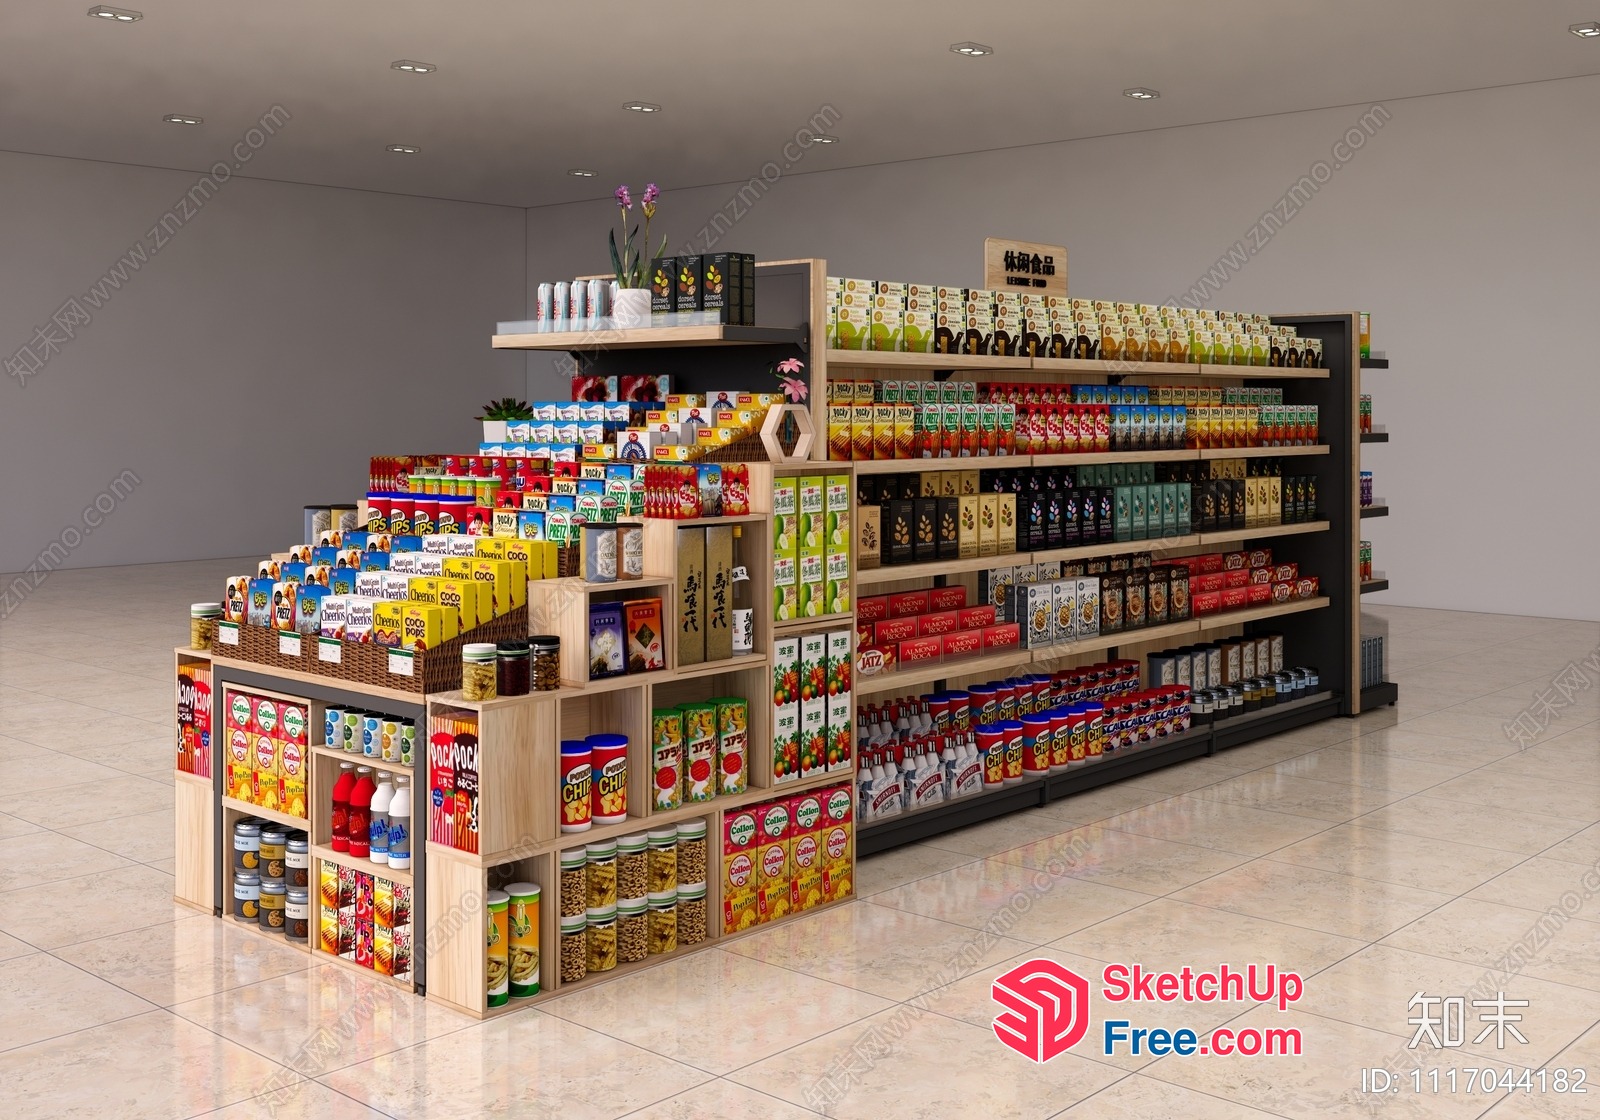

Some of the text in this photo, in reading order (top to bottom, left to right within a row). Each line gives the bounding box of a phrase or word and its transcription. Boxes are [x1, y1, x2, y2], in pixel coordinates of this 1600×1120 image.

[1004, 250, 1055, 275] 休闲食品
[893, 599, 924, 609] ALMOND
[933, 594, 963, 604] ALMOND
[939, 600, 958, 608] ROCA
[899, 606, 919, 614] ROCA
[963, 612, 992, 623] ALMOND
[967, 619, 986, 627] ROCA
[880, 626, 913, 637] ALMOND
[886, 632, 907, 641] ROCA
[987, 632, 1016, 643] ALMOND
[992, 639, 1011, 647] ROCA
[947, 639, 978, 649] ALMOND
[905, 645, 938, 656] ALMOND
[953, 646, 972, 654] ROCA
[911, 653, 932, 661] ROCA
[860, 656, 882, 670] JATZ
[232, 703, 251, 715] Collon
[257, 708, 277, 721] Collon
[284, 714, 303, 726] Collon
[829, 798, 850, 811] Collon
[798, 806, 819, 819] Collon
[765, 815, 787, 827] Collon
[732, 822, 754, 835] Collon
[828, 837, 846, 849] Collon
[764, 855, 784, 868] Collon
[731, 865, 751, 877] Collon
